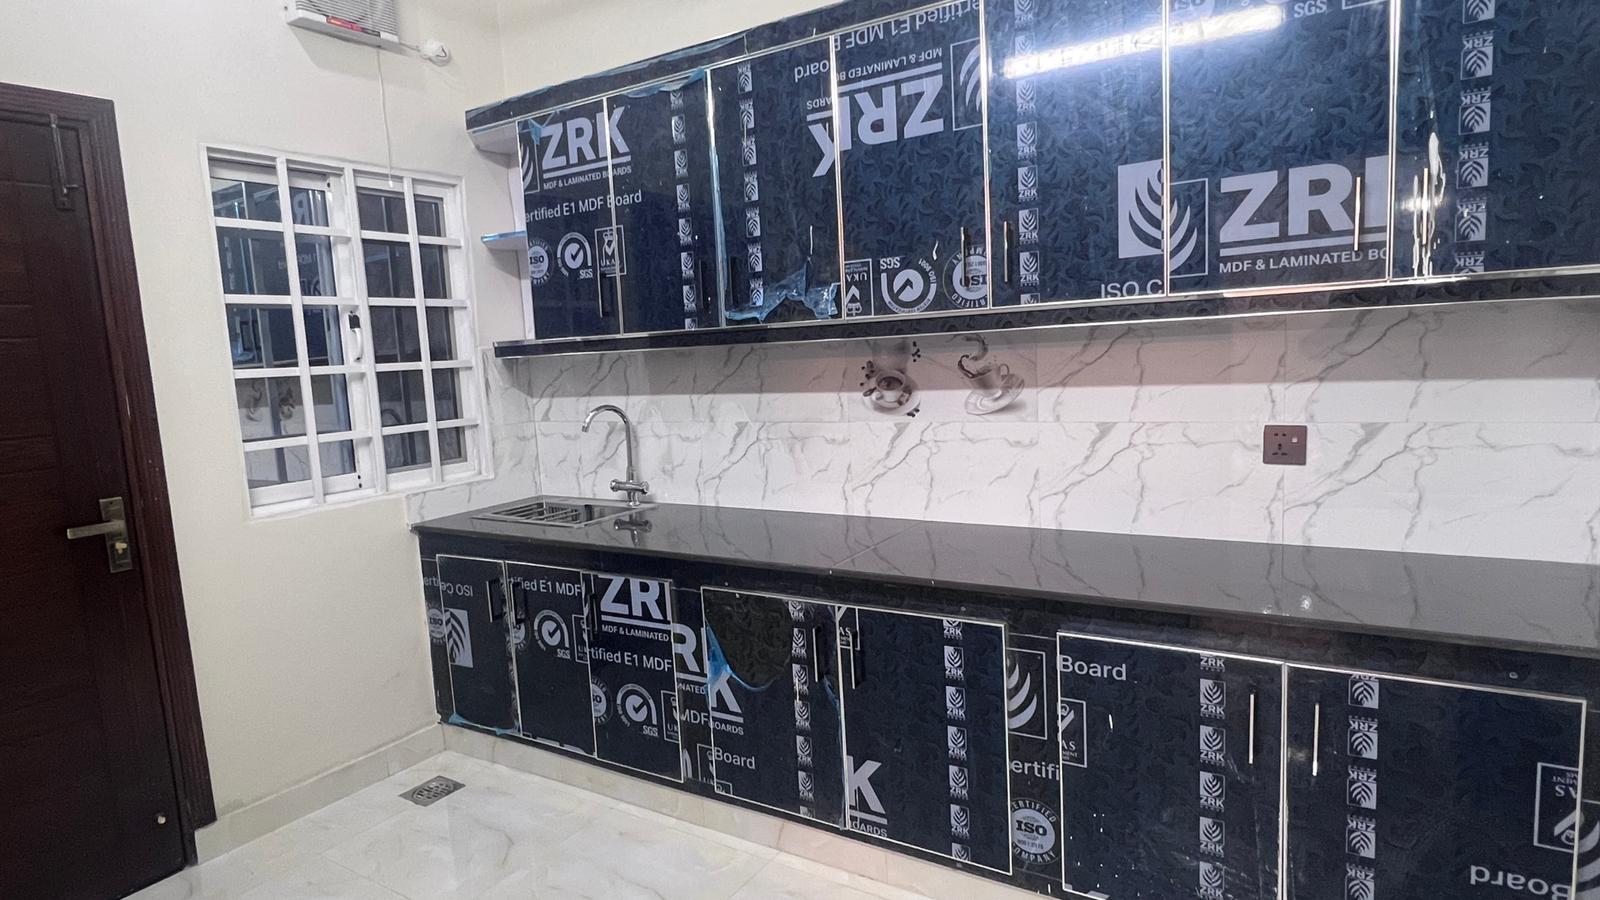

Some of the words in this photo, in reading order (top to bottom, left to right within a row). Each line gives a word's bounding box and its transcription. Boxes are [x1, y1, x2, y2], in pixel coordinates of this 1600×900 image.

[916, 1, 980, 29] ertified
[1293, 1, 1328, 18] SGS
[891, 21, 910, 36] E1
[846, 26, 884, 48] MDF
[1463, 36, 1494, 49] ZRK
[919, 47, 943, 61] MDF
[848, 57, 908, 79] LAMINATED
[1461, 93, 1491, 106] ZRK
[541, 106, 630, 170] ZRK
[1459, 148, 1489, 160] ZRK
[543, 179, 559, 190] MDF
[564, 172, 601, 186] LAMINATED
[602, 165, 632, 179] BARDS
[1019, 189, 1038, 198] ZRK
[525, 203, 560, 220] ertified
[563, 203, 575, 216] E1
[579, 196, 604, 212] MDF
[1020, 231, 1038, 240] ZRK
[880, 257, 901, 270] SGS
[1219, 260, 1252, 273] MDF
[1270, 250, 1364, 269] LAMINATED
[1455, 256, 1485, 267] ZRK
[579, 268, 594, 279] SGS
[846, 272, 868, 282] UKA
[1020, 273, 1040, 281] ZRK
[1101, 282, 1139, 299] ISO
[540, 580, 552, 593] E1
[555, 582, 581, 596] MDF
[601, 624, 618, 633] MDF
[625, 628, 669, 642] LAMINATED
[944, 627, 962, 635] ZRK
[624, 652, 639, 667] E1
[643, 655, 672, 672] MDF
[1057, 654, 1127, 681] Board
[1200, 657, 1225, 667] ZRK
[945, 668, 963, 676] ZRK
[1200, 704, 1225, 715] ZRK
[642, 725, 658, 737] SGS
[1349, 720, 1378, 733] ZRK
[713, 747, 756, 770] Board
[1200, 750, 1224, 762] ZRK
[1349, 769, 1377, 783] ZRK
[1200, 796, 1224, 808] ZRK
[849, 821, 888, 838] OARDS
[1016, 820, 1047, 836] ISO
[1348, 819, 1376, 832] ZRK
[1200, 842, 1224, 853] ZRK
[1347, 867, 1375, 880] ZRK
[1200, 886, 1223, 898] ZRK
